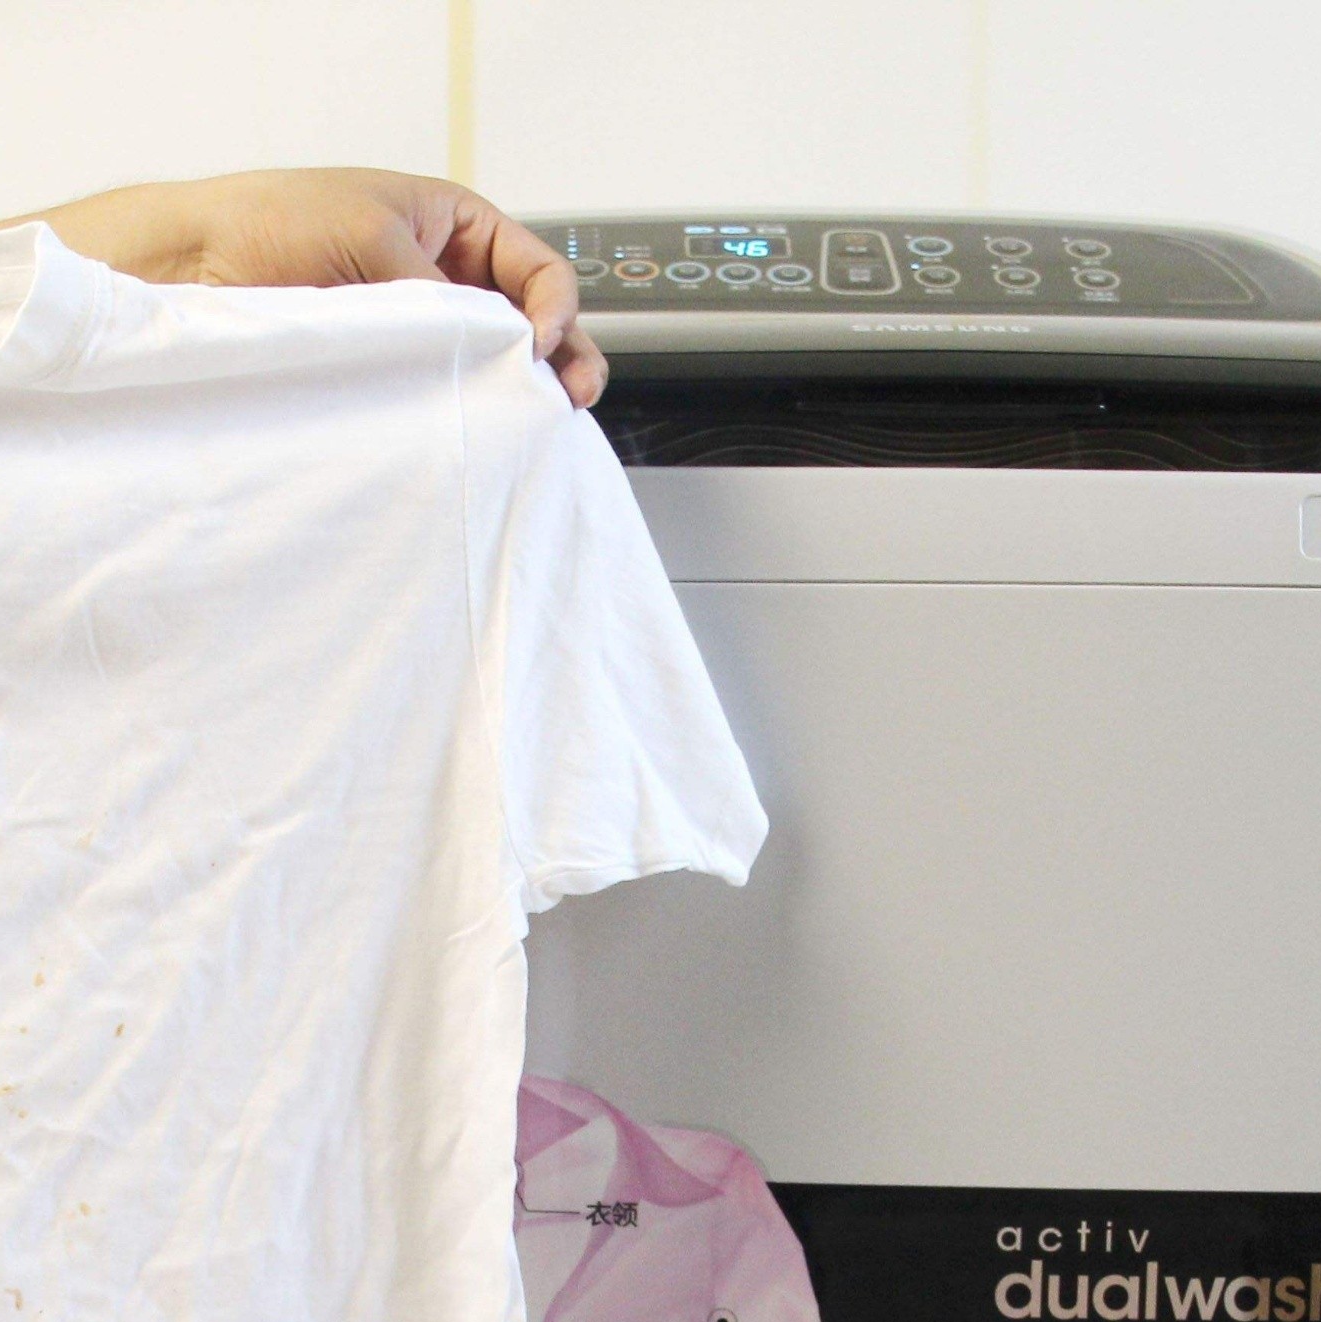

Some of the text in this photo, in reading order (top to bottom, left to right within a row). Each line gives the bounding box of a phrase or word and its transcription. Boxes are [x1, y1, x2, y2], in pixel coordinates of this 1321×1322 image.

[723, 240, 769, 257] 46
[852, 323, 1031, 333] SAMSUNG
[585, 1201, 639, 1228] 衣领
[996, 1220, 1150, 1254] activ
